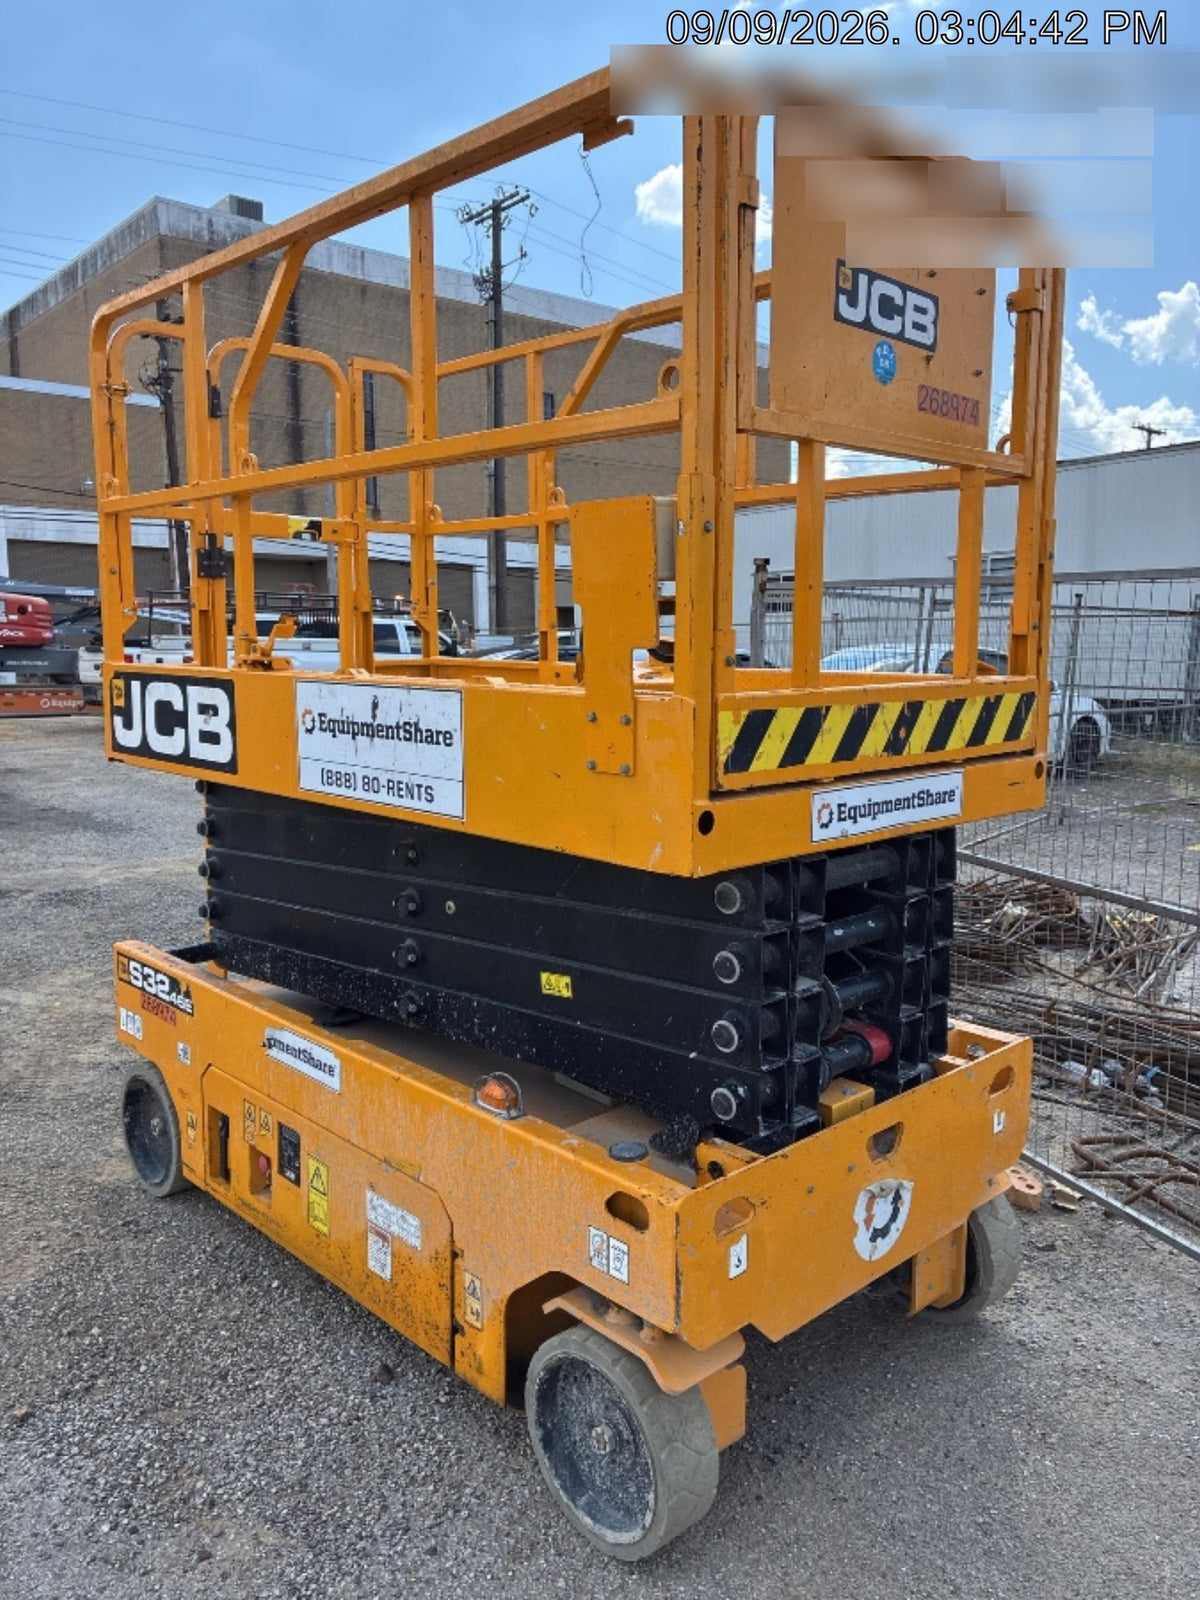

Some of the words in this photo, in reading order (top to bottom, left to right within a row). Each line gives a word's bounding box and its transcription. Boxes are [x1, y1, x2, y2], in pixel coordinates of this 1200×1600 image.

[838, 273, 937, 346] JCB
[917, 384, 979, 426] 268974
[113, 680, 234, 763] JCB
[317, 712, 455, 748] EquipmentShare
[320, 767, 358, 792] (888)
[361, 775, 435, 804] 80-RENTS
[836, 788, 957, 825] EquipmentShare
